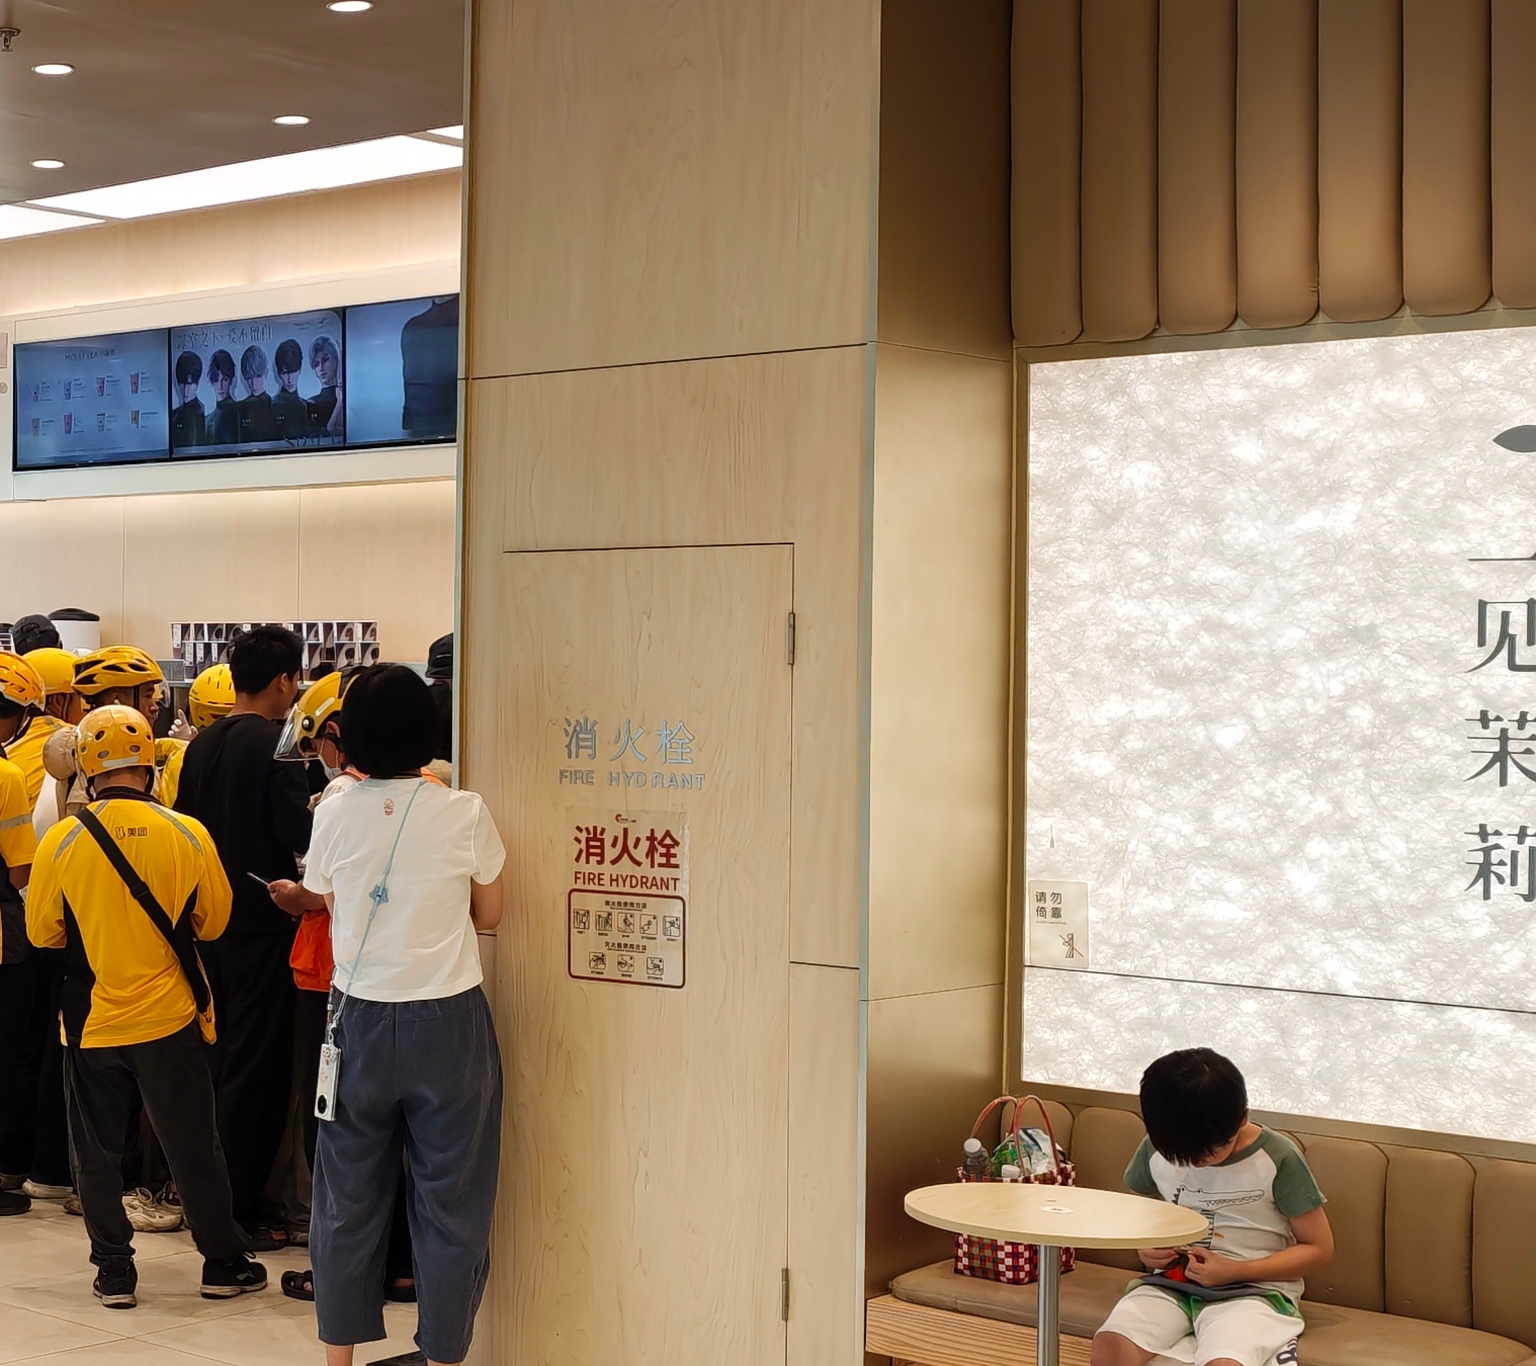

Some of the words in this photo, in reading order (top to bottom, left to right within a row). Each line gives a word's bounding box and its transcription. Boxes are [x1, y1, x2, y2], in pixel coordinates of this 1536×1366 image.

[563, 715, 695, 764] 消火栓
[559, 769, 595, 785] FIRE
[573, 825, 680, 869] 消火栓
[574, 871, 605, 887] FIRE
[609, 873, 680, 891] HYDRANT
[1035, 891, 1062, 905] 请勿
